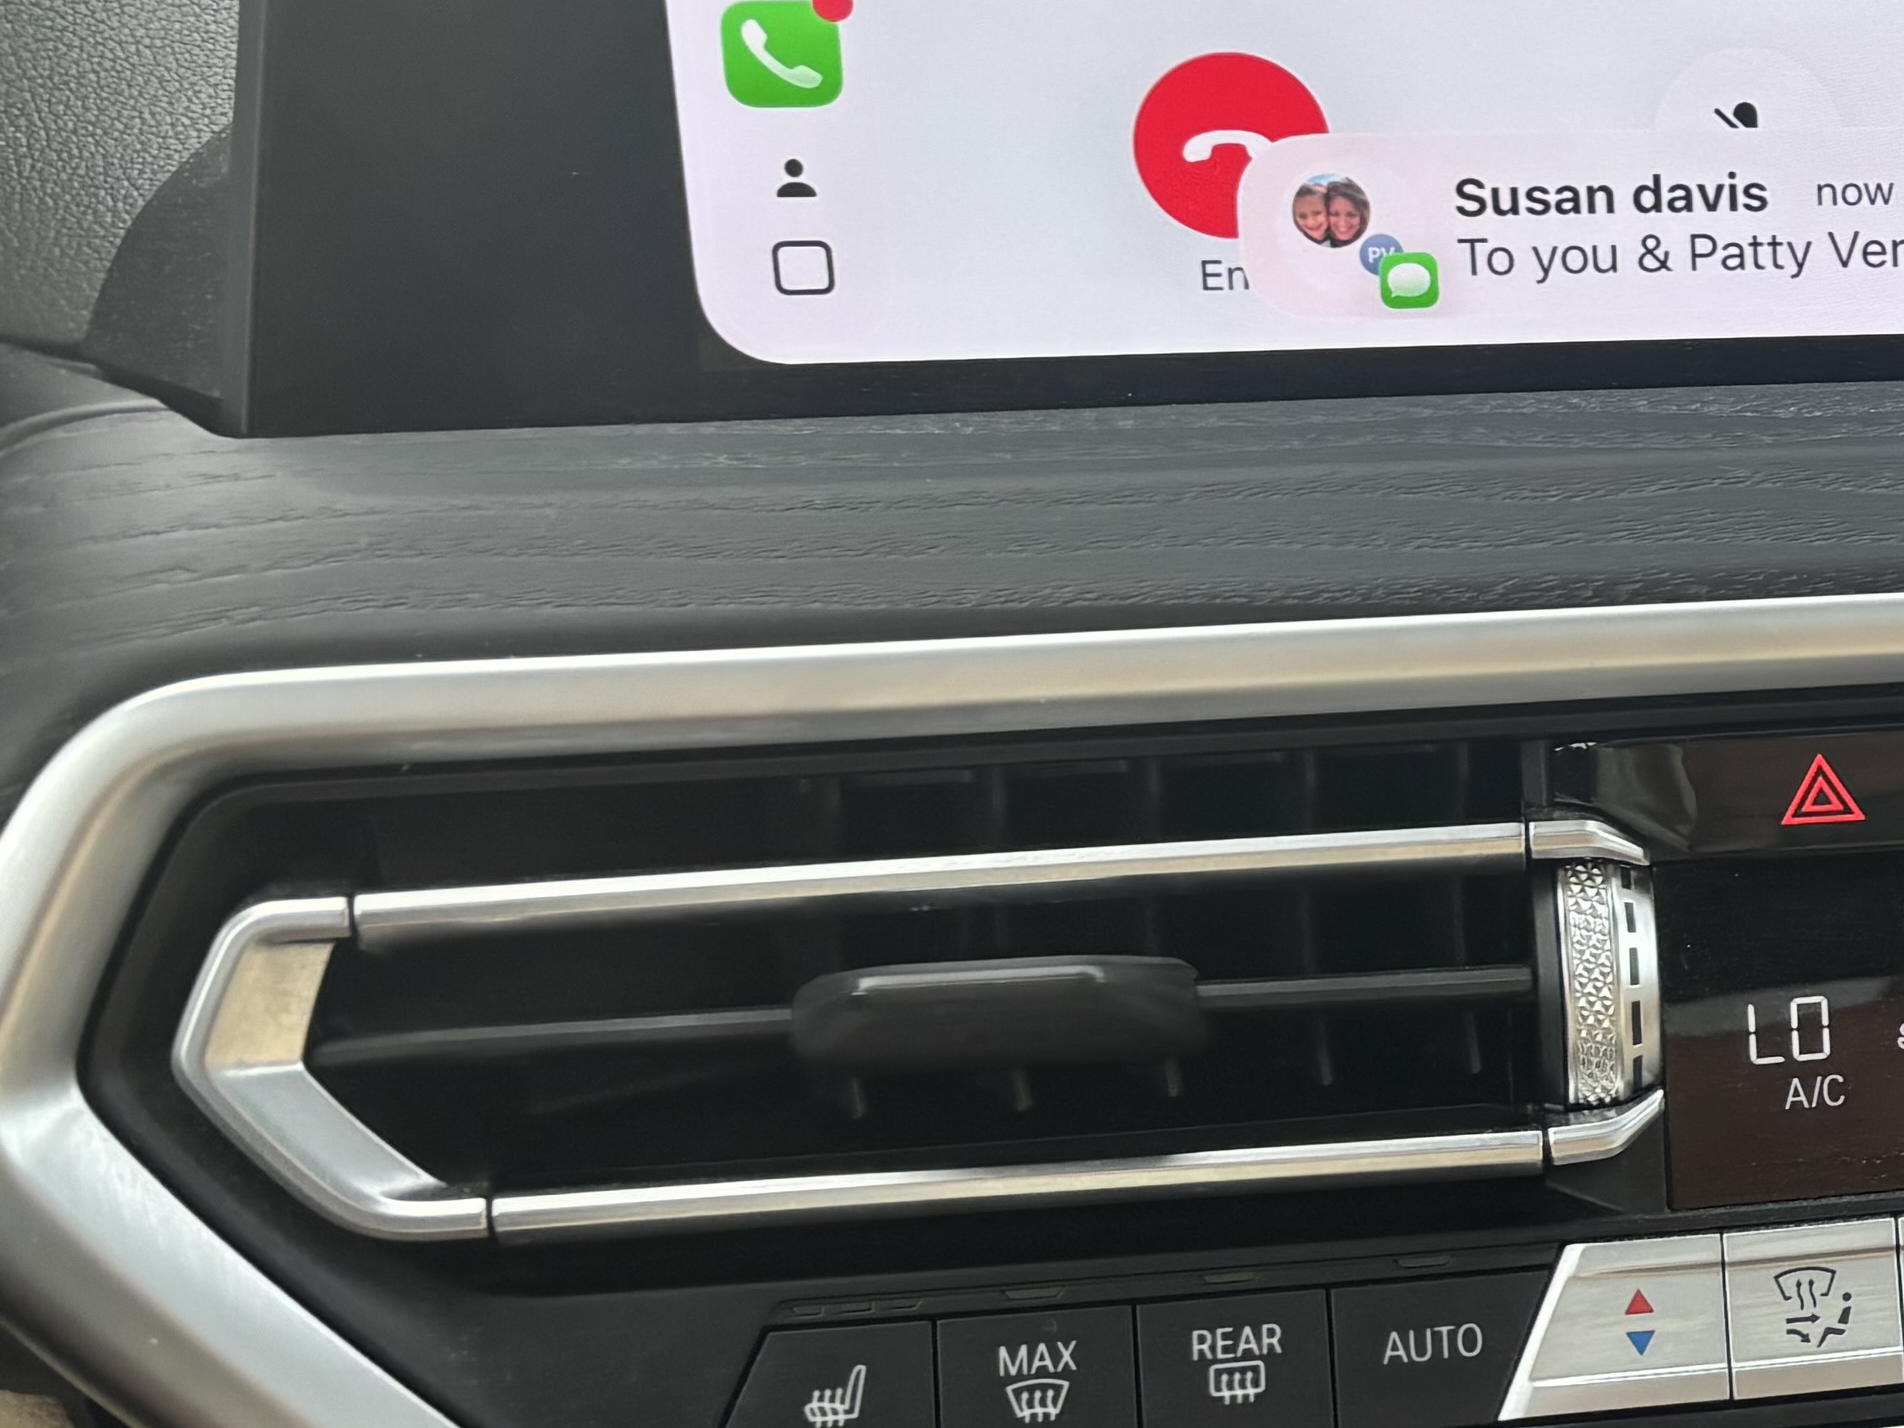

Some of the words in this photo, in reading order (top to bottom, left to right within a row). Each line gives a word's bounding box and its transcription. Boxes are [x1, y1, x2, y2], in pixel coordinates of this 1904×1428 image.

[1455, 177, 1615, 218] Susan
[1632, 171, 1769, 214] davis
[1816, 182, 1894, 207] now
[1200, 259, 1250, 291] En
[1456, 237, 1515, 276] To
[1531, 244, 1618, 285] you
[1637, 233, 1673, 273] &
[1689, 233, 1812, 280] Patty
[1747, 995, 1831, 1065] LO
[1785, 1074, 1845, 1110] A/C
[998, 1340, 1077, 1377] MAX
[1192, 1323, 1282, 1361] REAR
[1383, 1322, 1483, 1365] AUTO
